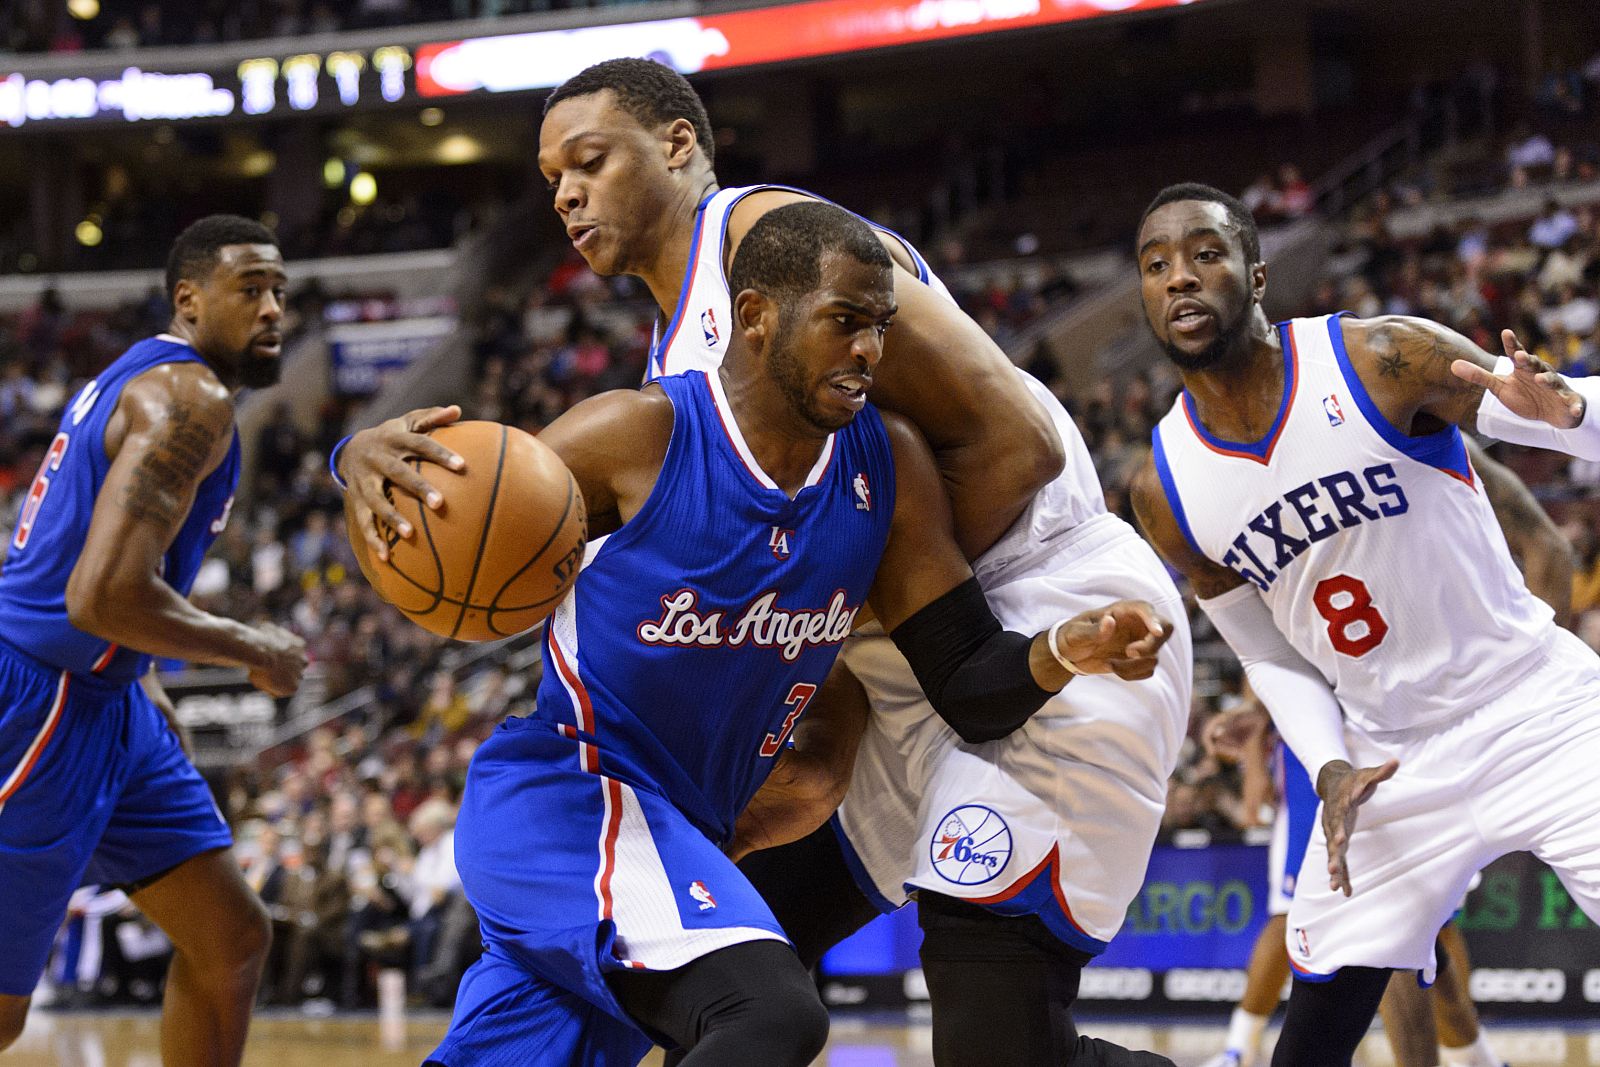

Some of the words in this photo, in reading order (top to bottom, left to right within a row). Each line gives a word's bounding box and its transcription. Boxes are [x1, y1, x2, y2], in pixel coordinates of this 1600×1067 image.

[14, 431, 70, 550] 6
[1222, 463, 1410, 592] SIXERS
[637, 588, 727, 649] Los
[1312, 573, 1389, 659] 8
[759, 682, 817, 757] 3
[937, 833, 998, 868] 76ers
